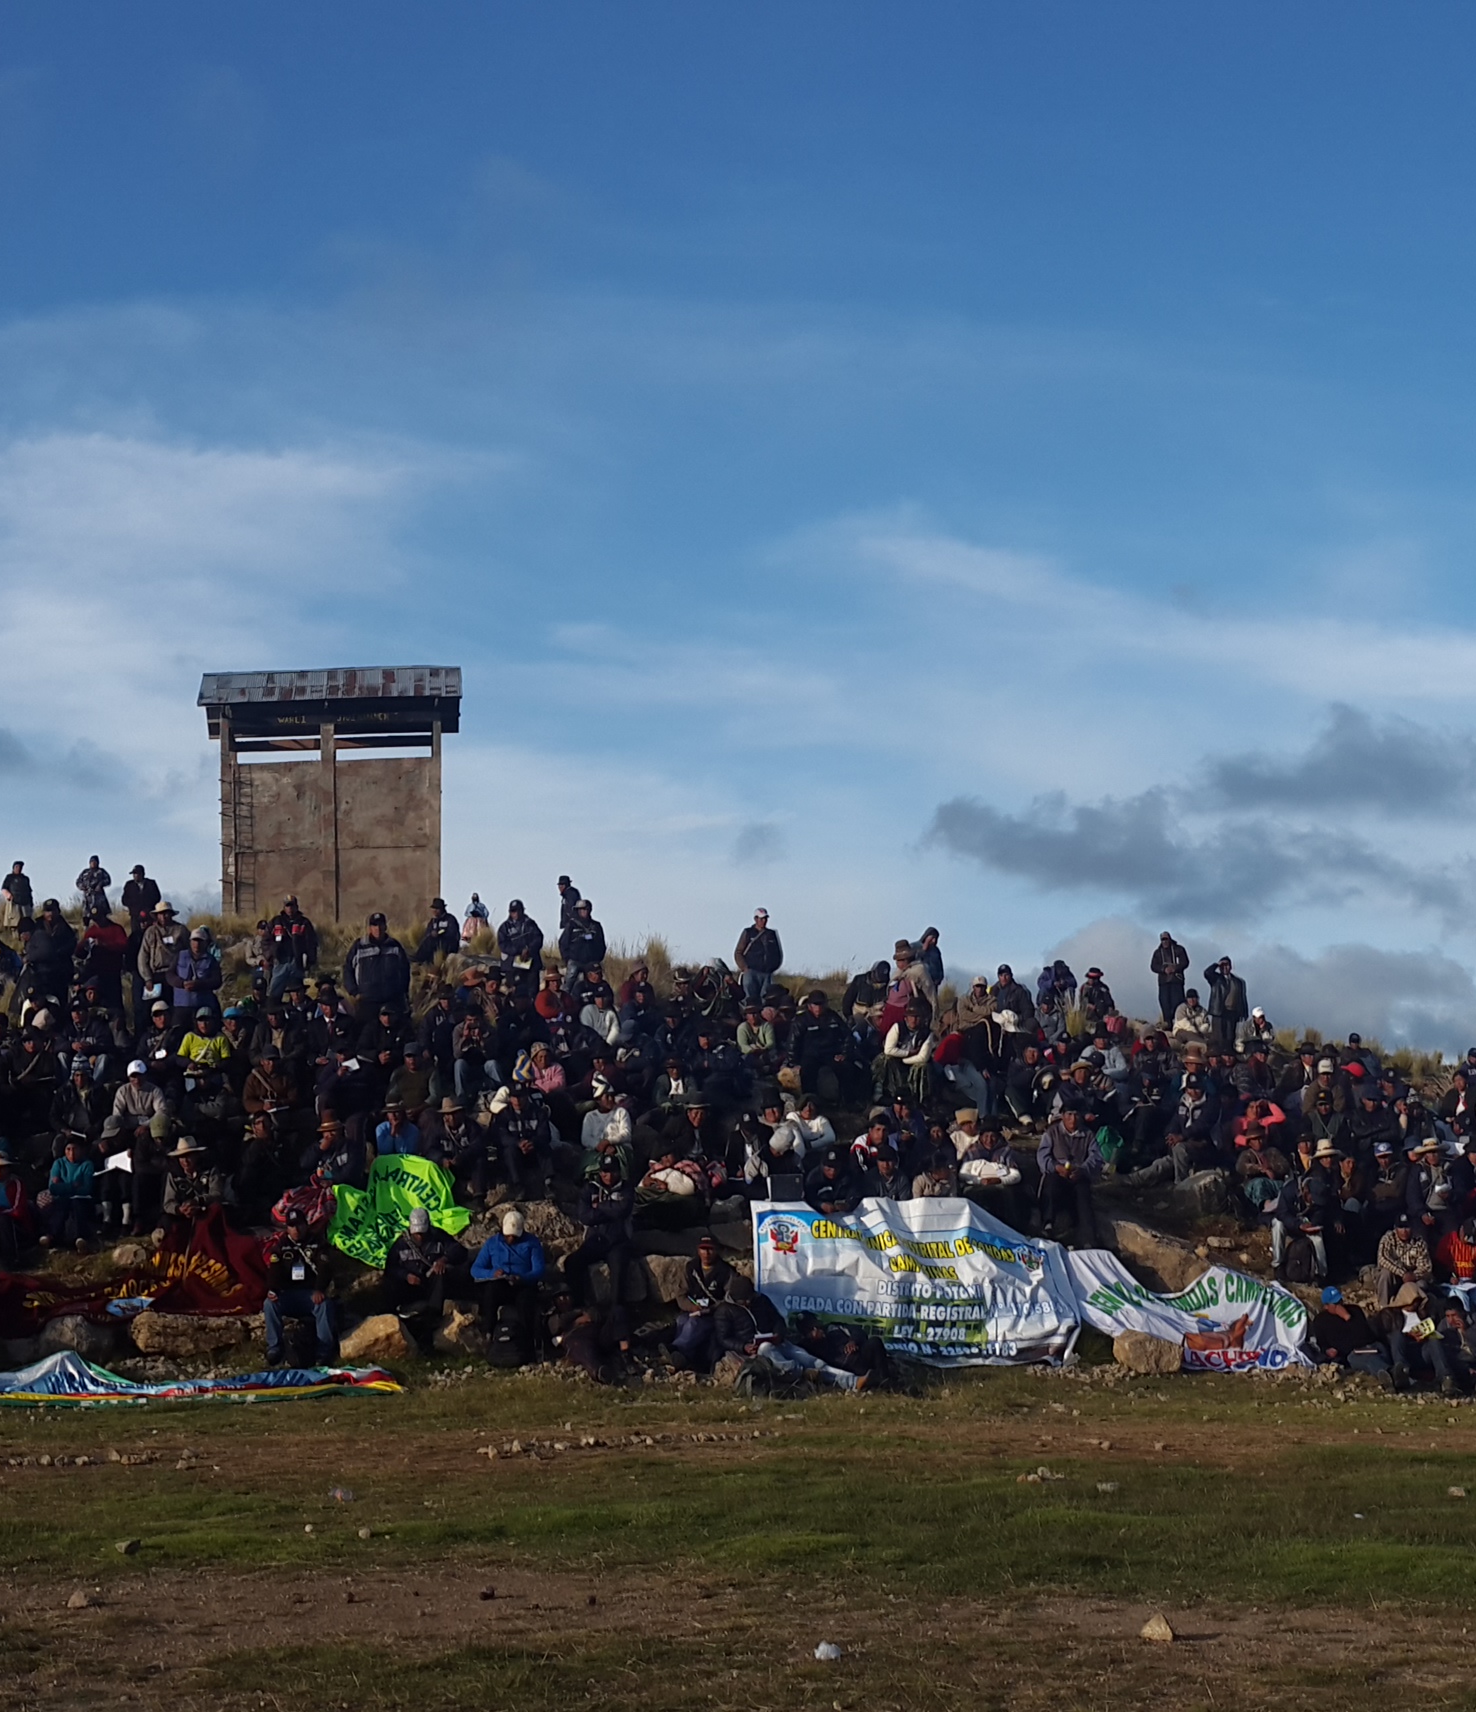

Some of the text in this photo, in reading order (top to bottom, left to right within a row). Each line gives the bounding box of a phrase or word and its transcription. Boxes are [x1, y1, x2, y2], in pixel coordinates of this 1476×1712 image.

[811, 1219, 863, 1241] CENTRAL
[954, 1236, 975, 1258] DE
[889, 1253, 959, 1280] CAMPSINAS
[783, 1294, 834, 1313] CREADA
[835, 1297, 863, 1316] CON
[866, 1300, 917, 1320] PARTIDA
[920, 1303, 986, 1321] REGISTRAL
[892, 1324, 915, 1339] LEY
[925, 1326, 967, 1341] 27908
